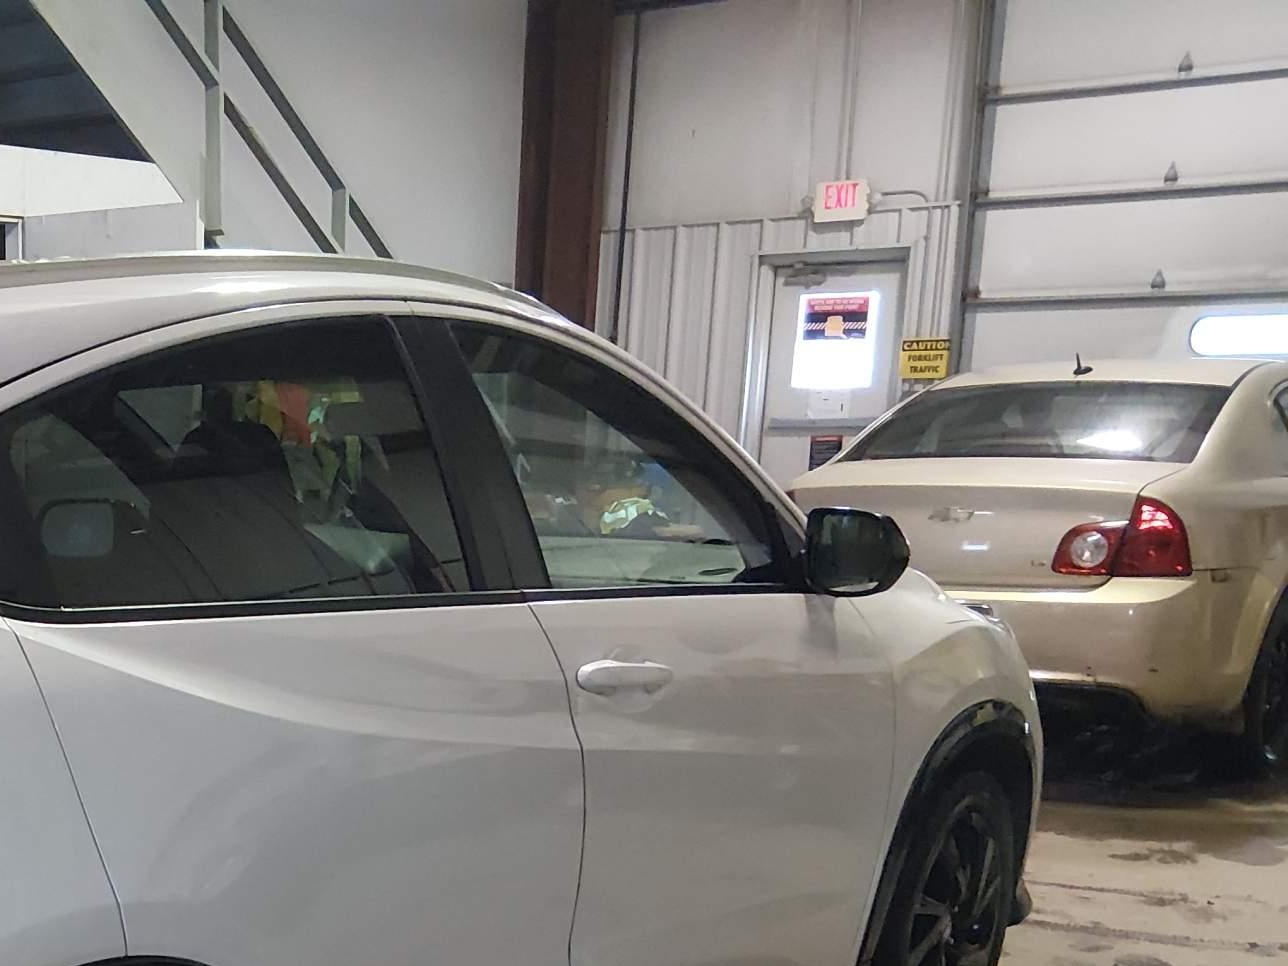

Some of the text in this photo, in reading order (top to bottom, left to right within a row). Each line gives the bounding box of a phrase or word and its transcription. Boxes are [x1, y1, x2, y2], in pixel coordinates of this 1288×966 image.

[824, 182, 860, 210] EXIT
[907, 353, 944, 362] FORKLIFT
[909, 365, 940, 374] TRAFFIC
